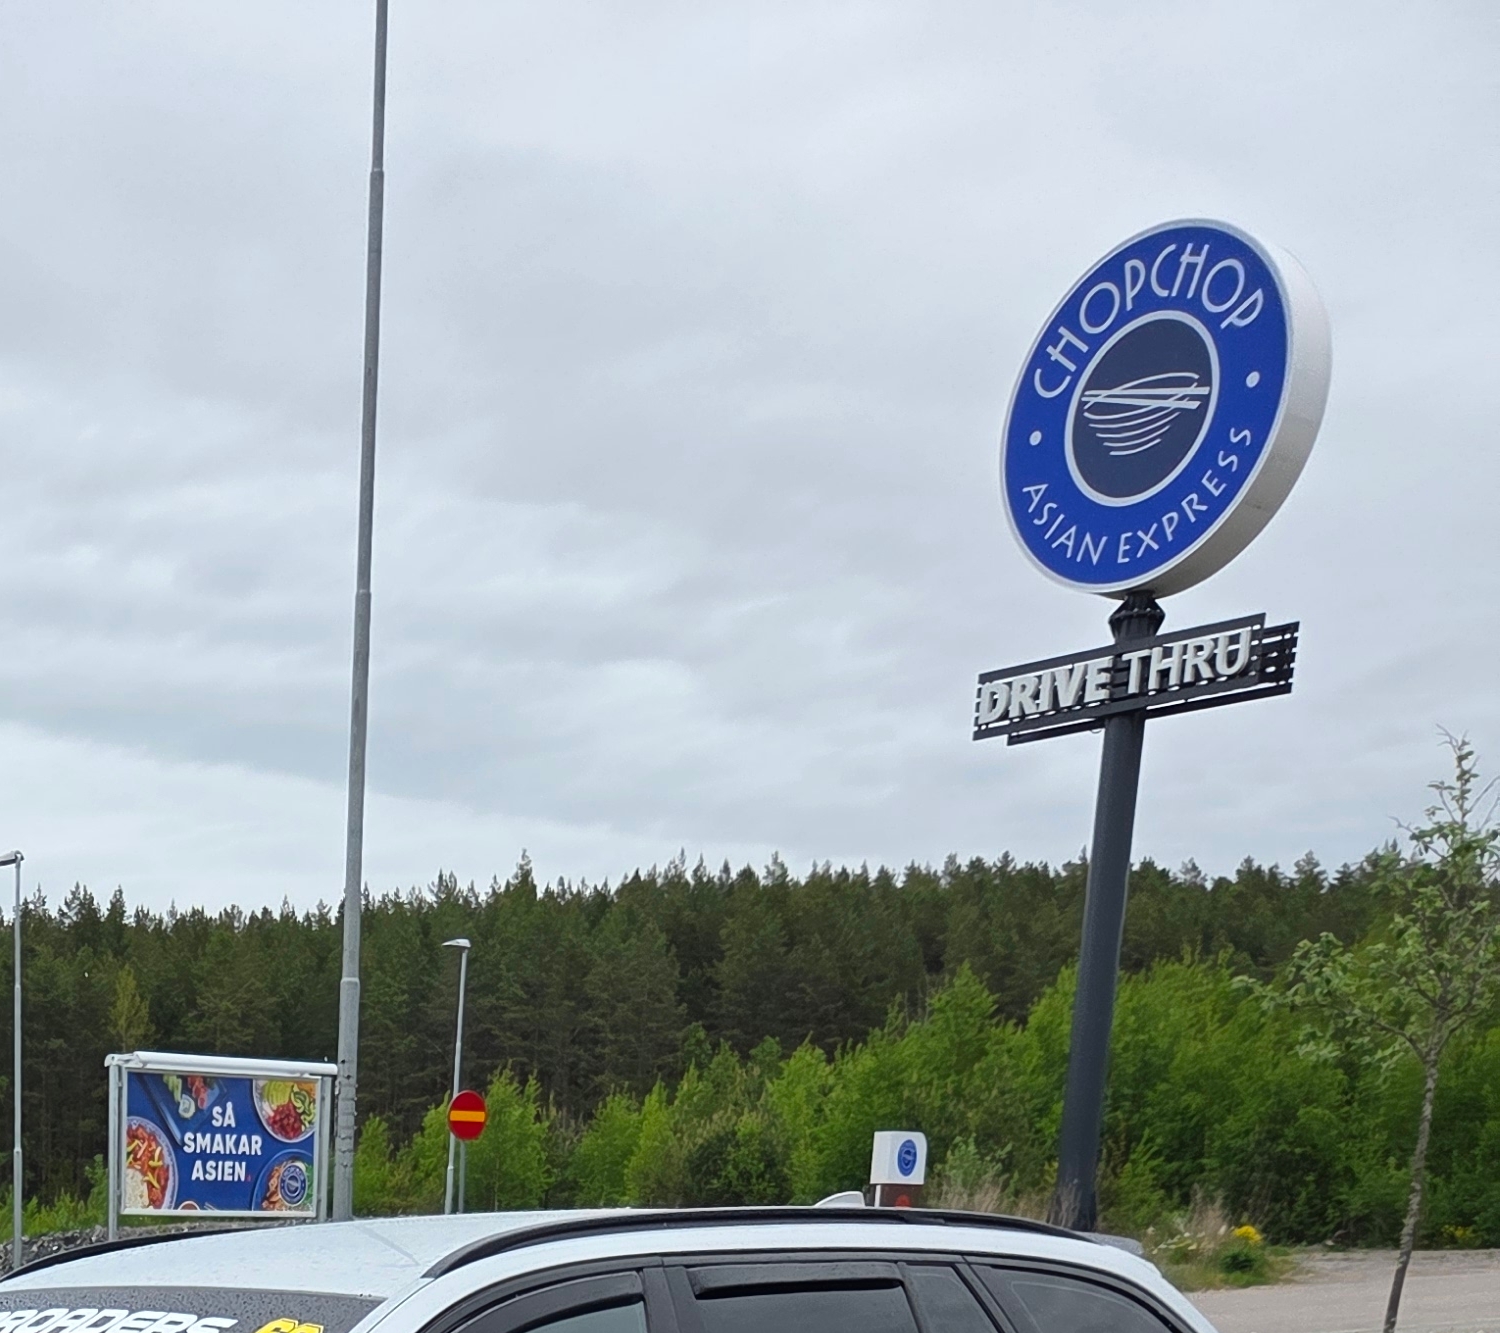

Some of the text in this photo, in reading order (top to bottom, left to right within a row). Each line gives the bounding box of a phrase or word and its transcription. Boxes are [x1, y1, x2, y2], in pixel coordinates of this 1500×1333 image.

[1033, 243, 1263, 399] CHOPCHOP
[1022, 426, 1252, 566] ASIAN EXPRESS
[978, 628, 1252, 726] DRIVE THRU
[182, 1131, 262, 1156] SMAKAR
[211, 1101, 236, 1128] SÅ
